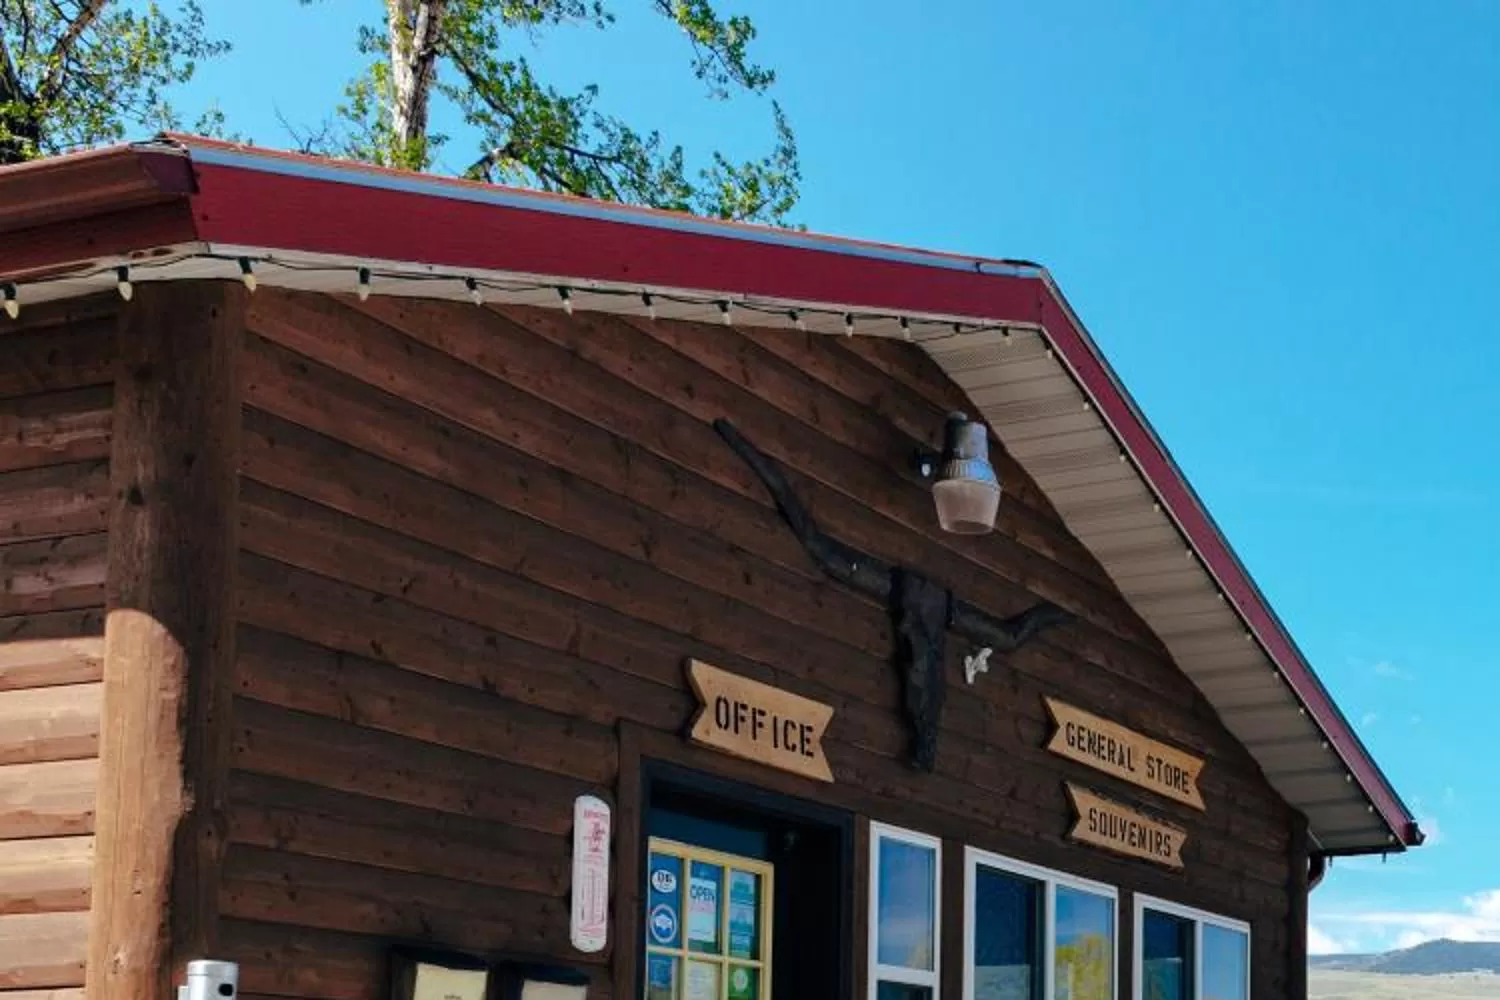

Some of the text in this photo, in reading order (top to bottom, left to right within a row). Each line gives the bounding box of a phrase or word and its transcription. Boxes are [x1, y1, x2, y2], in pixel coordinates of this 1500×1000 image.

[715, 695, 814, 757] OFFICE
[1065, 721, 1190, 794] GENERAL STORE
[1088, 807, 1171, 857] SOUVENIRS
[690, 884, 715, 902] OPEN
